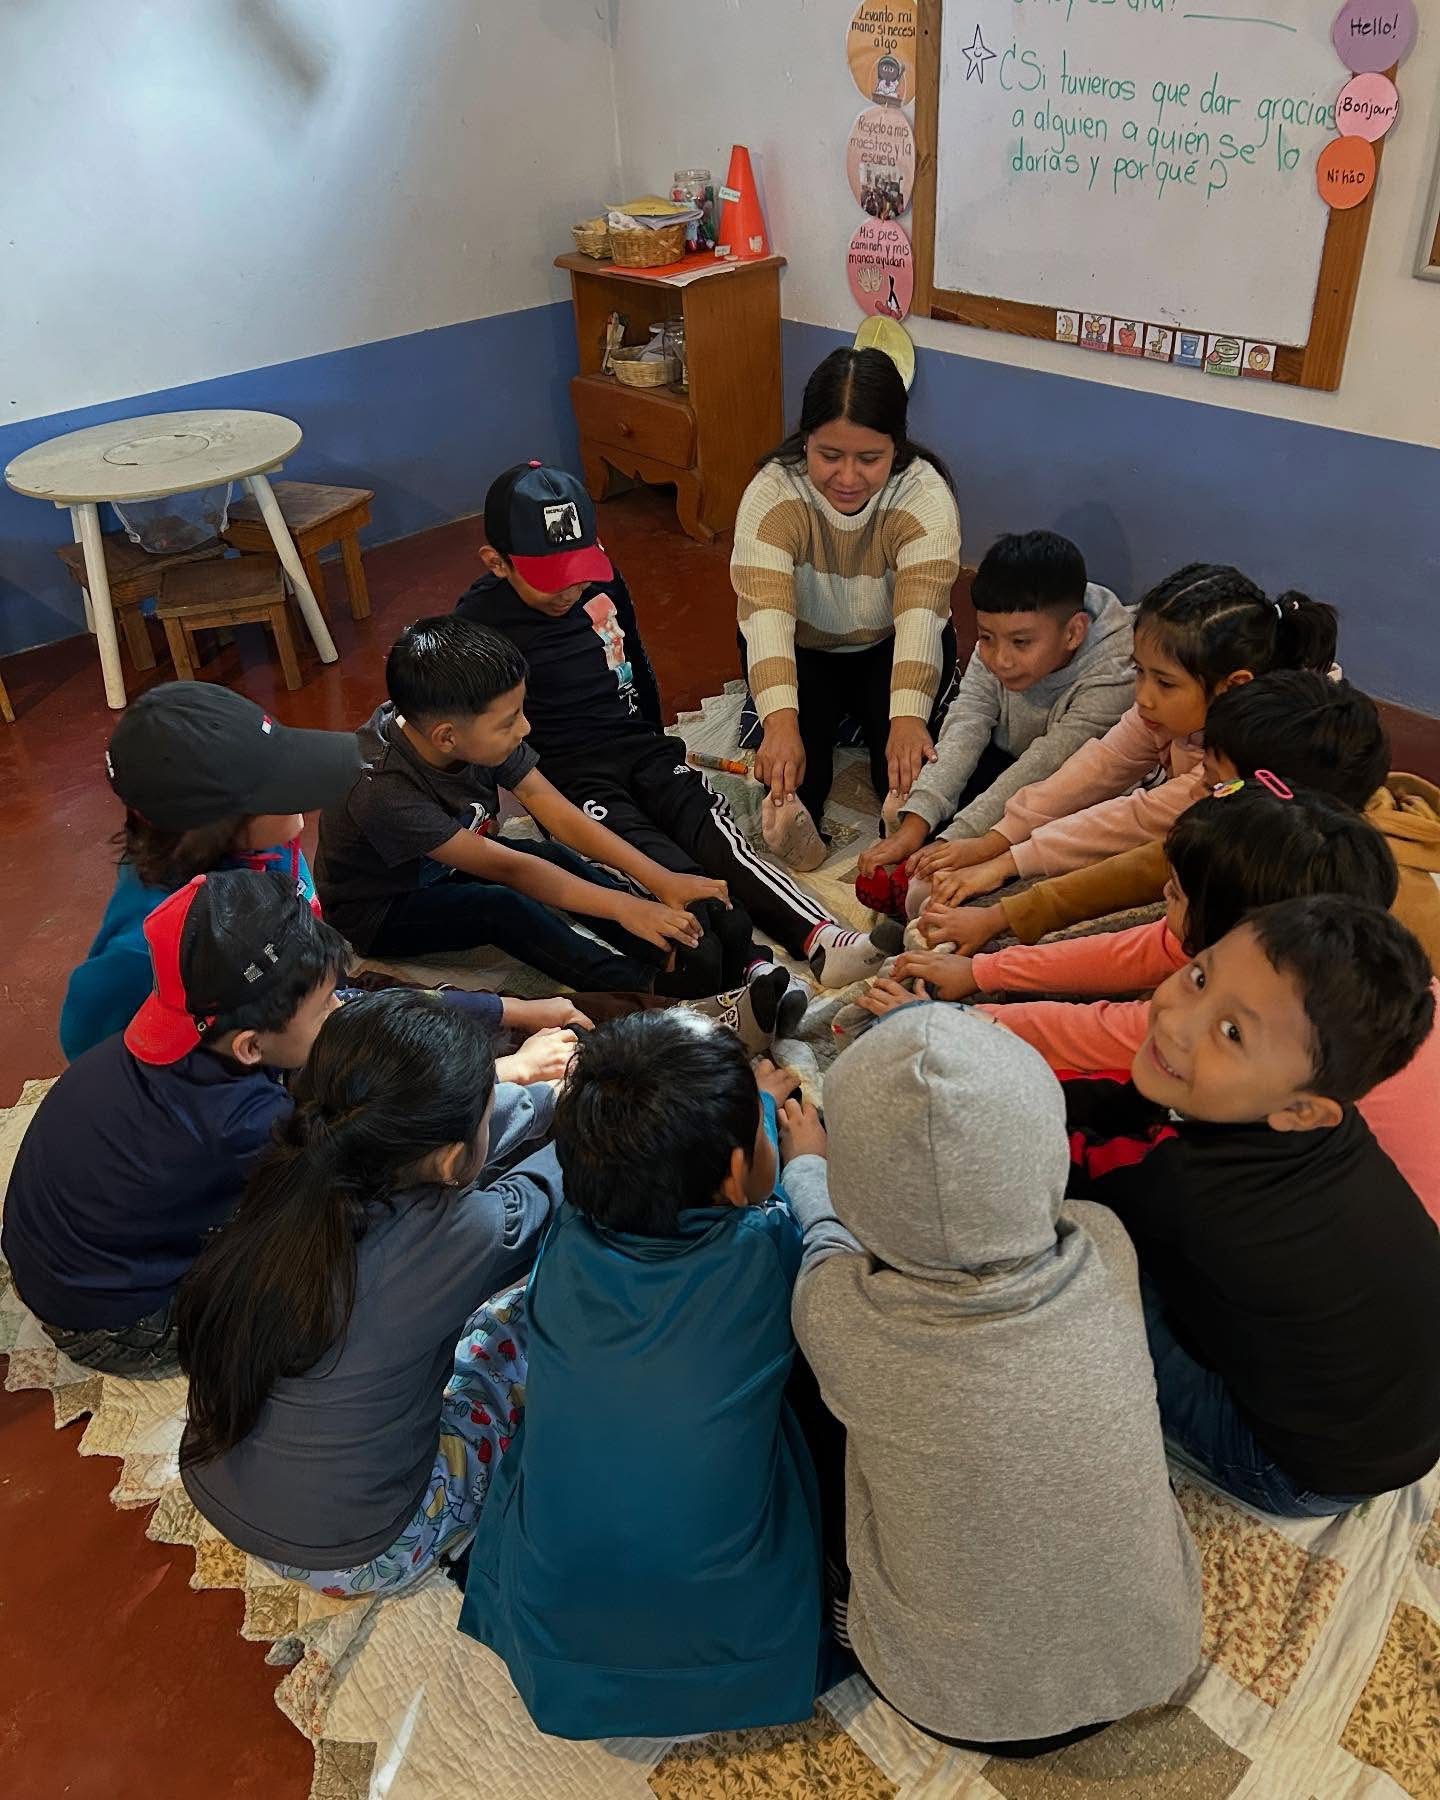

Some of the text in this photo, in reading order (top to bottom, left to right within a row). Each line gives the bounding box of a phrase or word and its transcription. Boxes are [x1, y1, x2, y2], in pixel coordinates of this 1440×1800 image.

[859, 4, 912, 23] Levanto mi
[851, 21, 876, 34] mano
[1350, 13, 1399, 39] Hello!
[873, 35, 898, 55] algo
[999, 35, 1047, 92] ¿Si
[1060, 49, 1136, 101] tuvieras
[1152, 80, 1192, 127] que
[1200, 71, 1242, 115] dar
[1011, 98, 1301, 173] a alguien a quién se lo
[850, 135, 912, 161] maestros y la
[861, 151, 896, 167] escuela
[1012, 136, 1080, 174] darías
[1087, 155, 1100, 191] y
[1113, 157, 1149, 195] por
[860, 226, 899, 245] Mis pies
[850, 240, 910, 259] caminan y mis
[848, 253, 905, 269] manos ayudan
